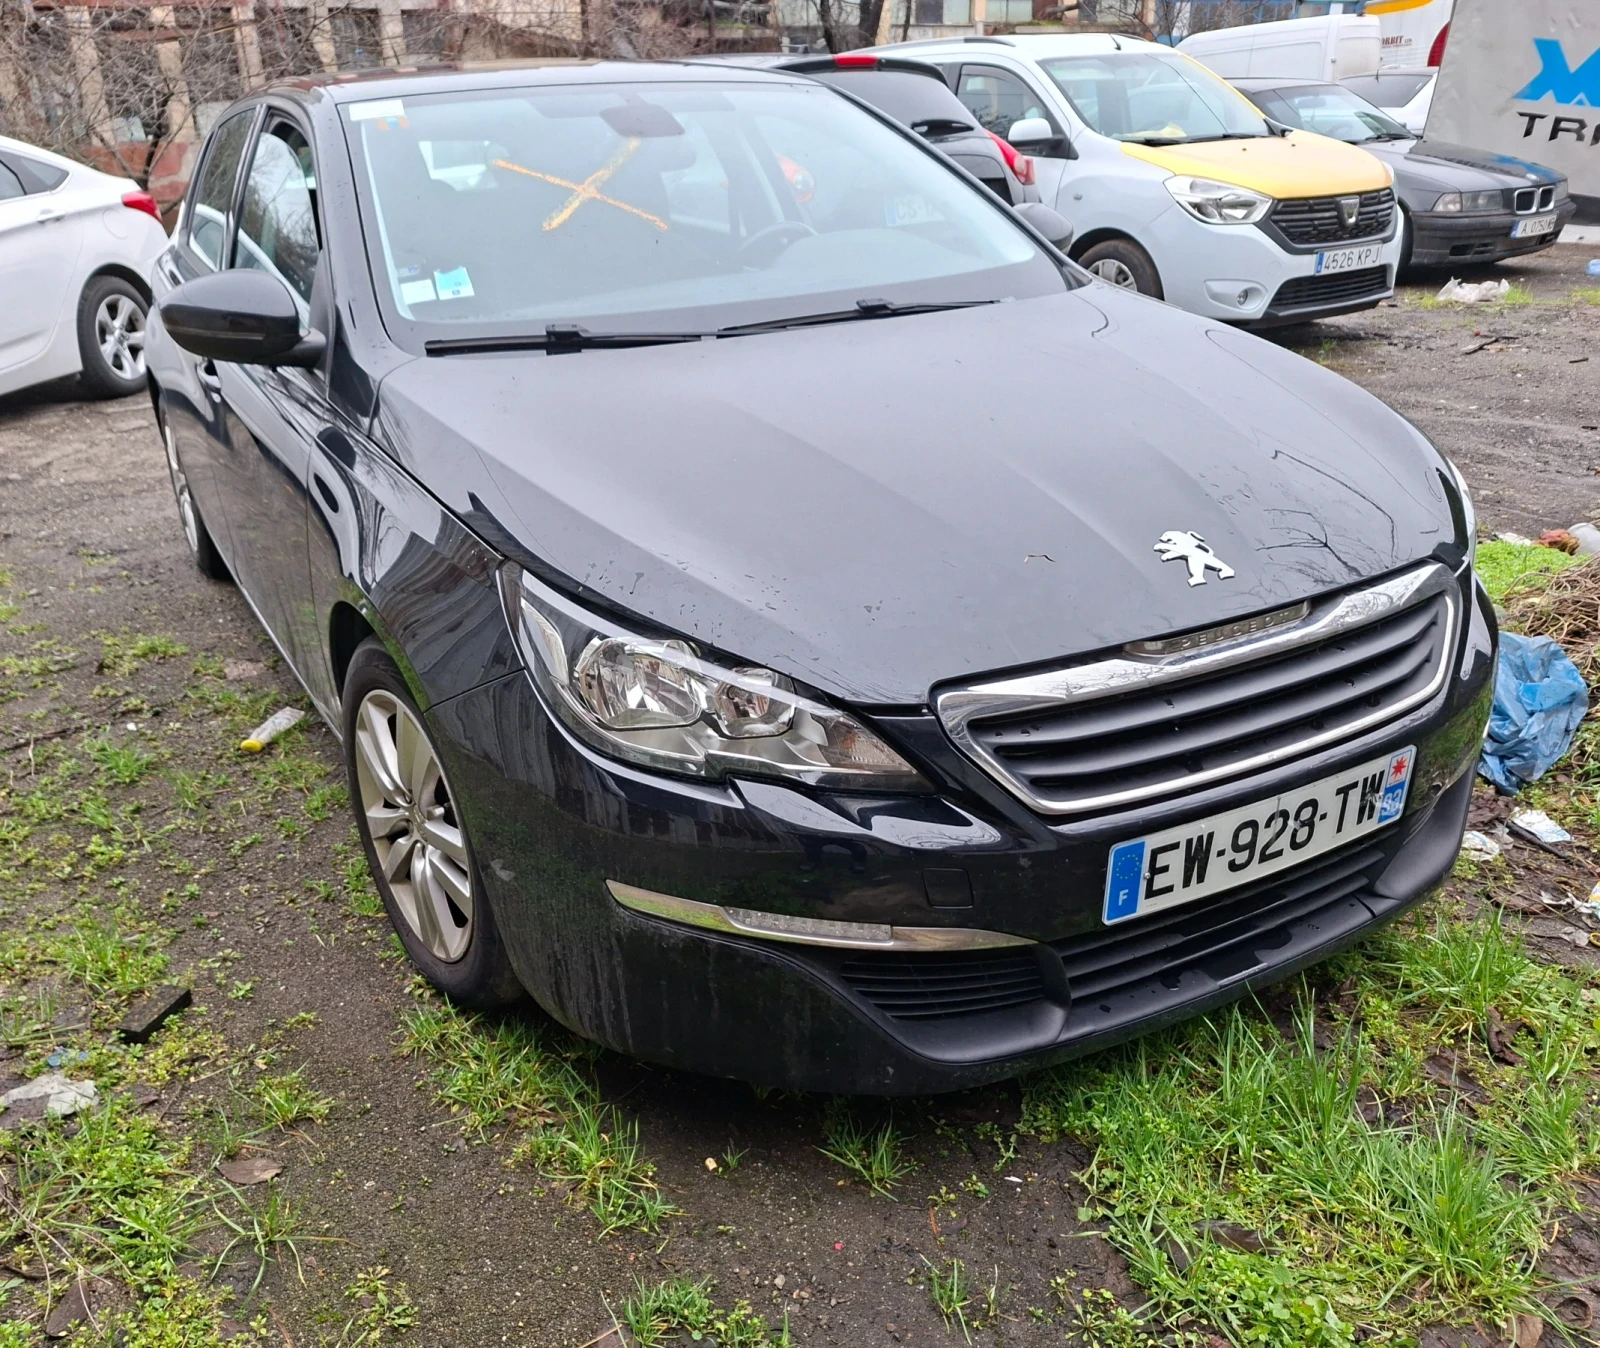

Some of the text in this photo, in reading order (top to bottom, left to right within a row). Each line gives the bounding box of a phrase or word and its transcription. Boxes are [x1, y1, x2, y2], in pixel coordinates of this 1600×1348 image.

[1324, 247, 1380, 270] 4526 KPJ
[1118, 769, 1386, 906] F EW-928-TW
